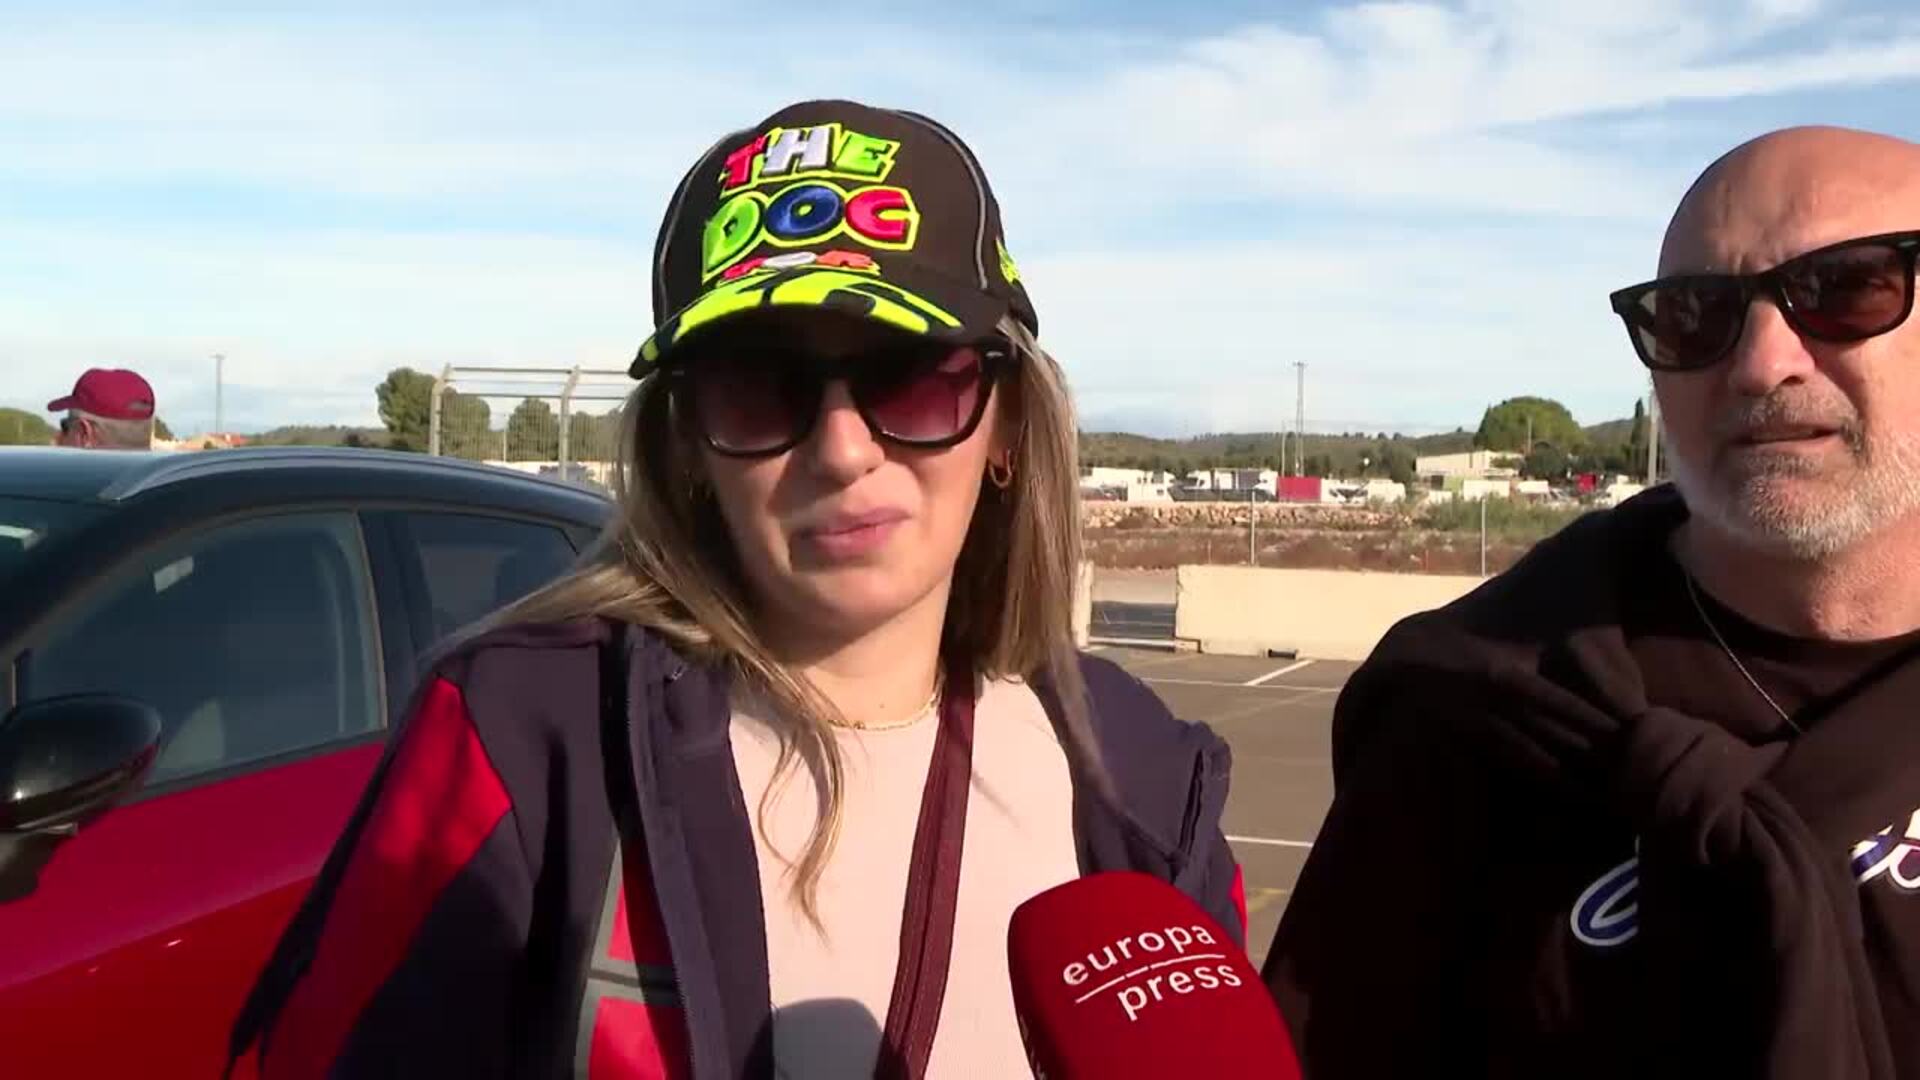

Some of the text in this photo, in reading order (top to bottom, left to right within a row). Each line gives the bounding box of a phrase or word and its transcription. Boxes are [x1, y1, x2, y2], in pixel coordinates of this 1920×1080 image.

[719, 123, 898, 194] THE
[702, 181, 918, 281] DOC
[1062, 925, 1216, 986] europa
[1117, 964, 1242, 1021] press
